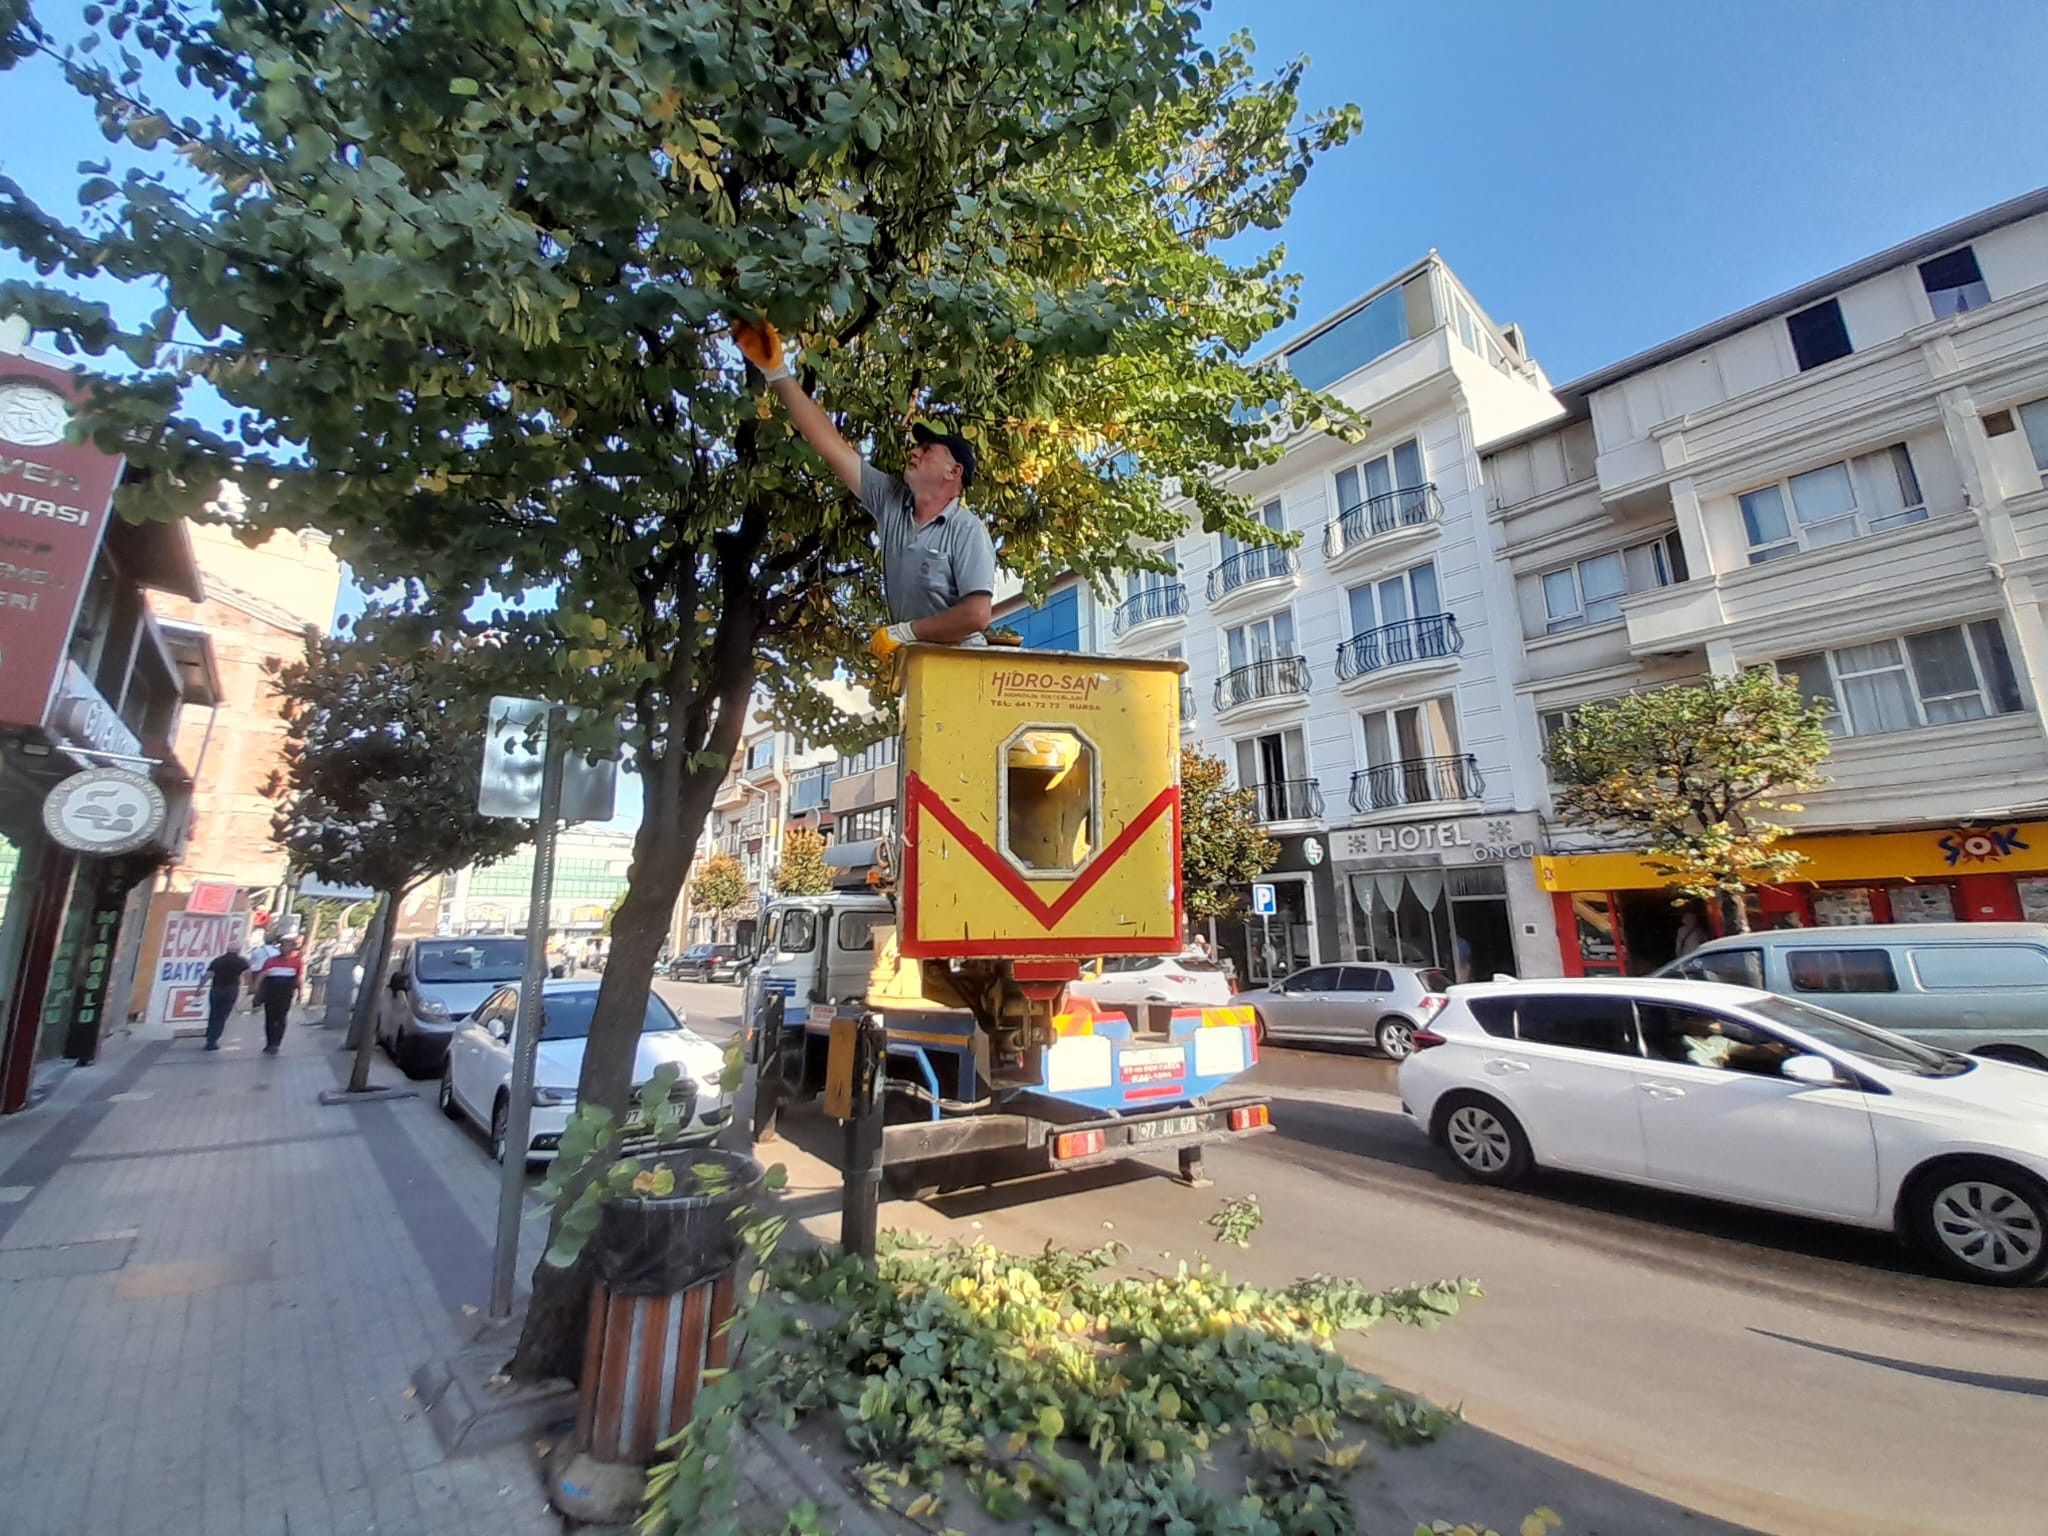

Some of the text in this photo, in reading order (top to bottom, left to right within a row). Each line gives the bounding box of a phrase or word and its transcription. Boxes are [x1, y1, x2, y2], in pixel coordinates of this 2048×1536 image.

[1069, 703, 1102, 711] BURSA
[1375, 822, 1472, 850] HOTEL
[1258, 888, 1272, 912] P
[161, 918, 243, 958] ECZANE
